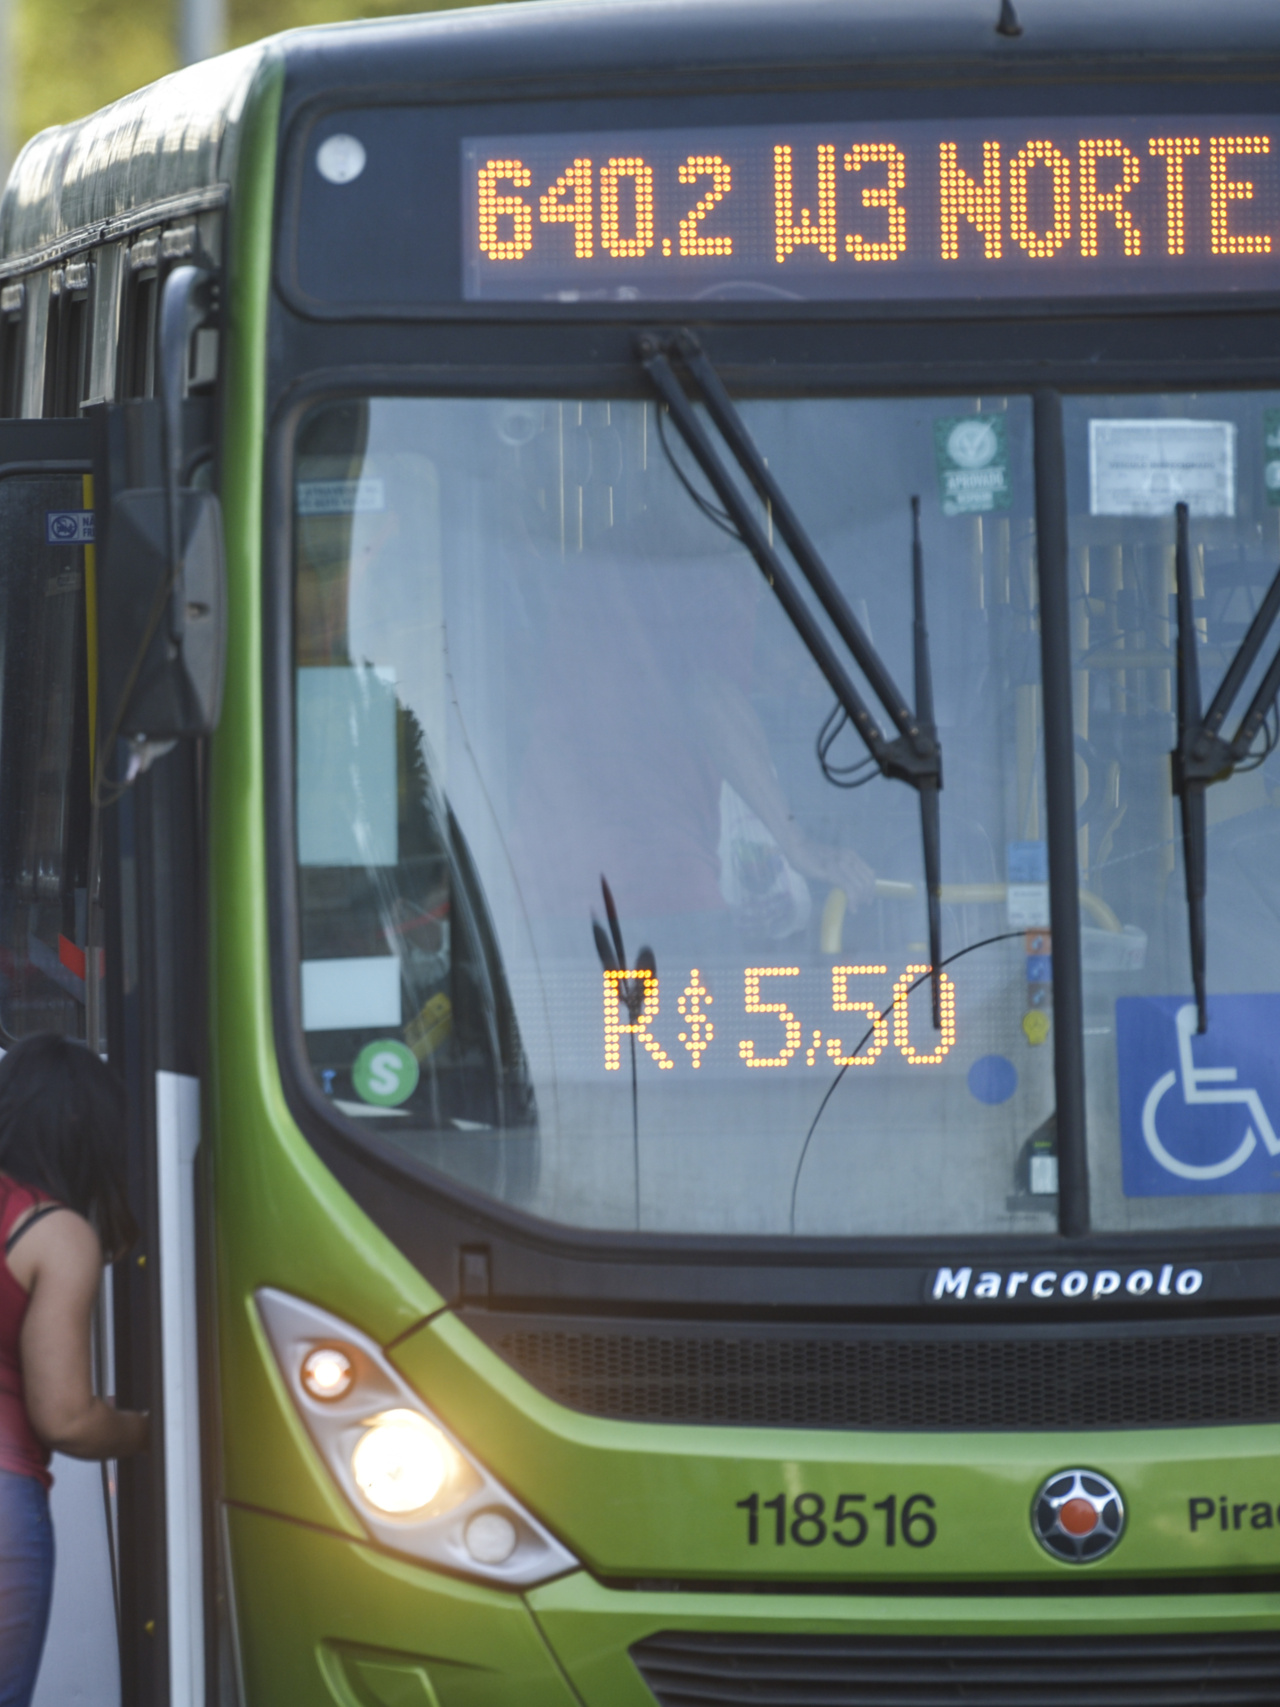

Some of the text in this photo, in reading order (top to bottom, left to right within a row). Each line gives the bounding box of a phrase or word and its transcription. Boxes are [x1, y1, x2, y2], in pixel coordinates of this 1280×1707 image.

[477, 135, 1273, 263] 640.2 W3 NORTE
[602, 964, 957, 1071] R$ 5,50
[368, 1051, 403, 1096] S
[932, 1264, 1204, 1300] Marcopolo
[736, 1492, 939, 1549] 118516
[1188, 1495, 1280, 1533] Pira
